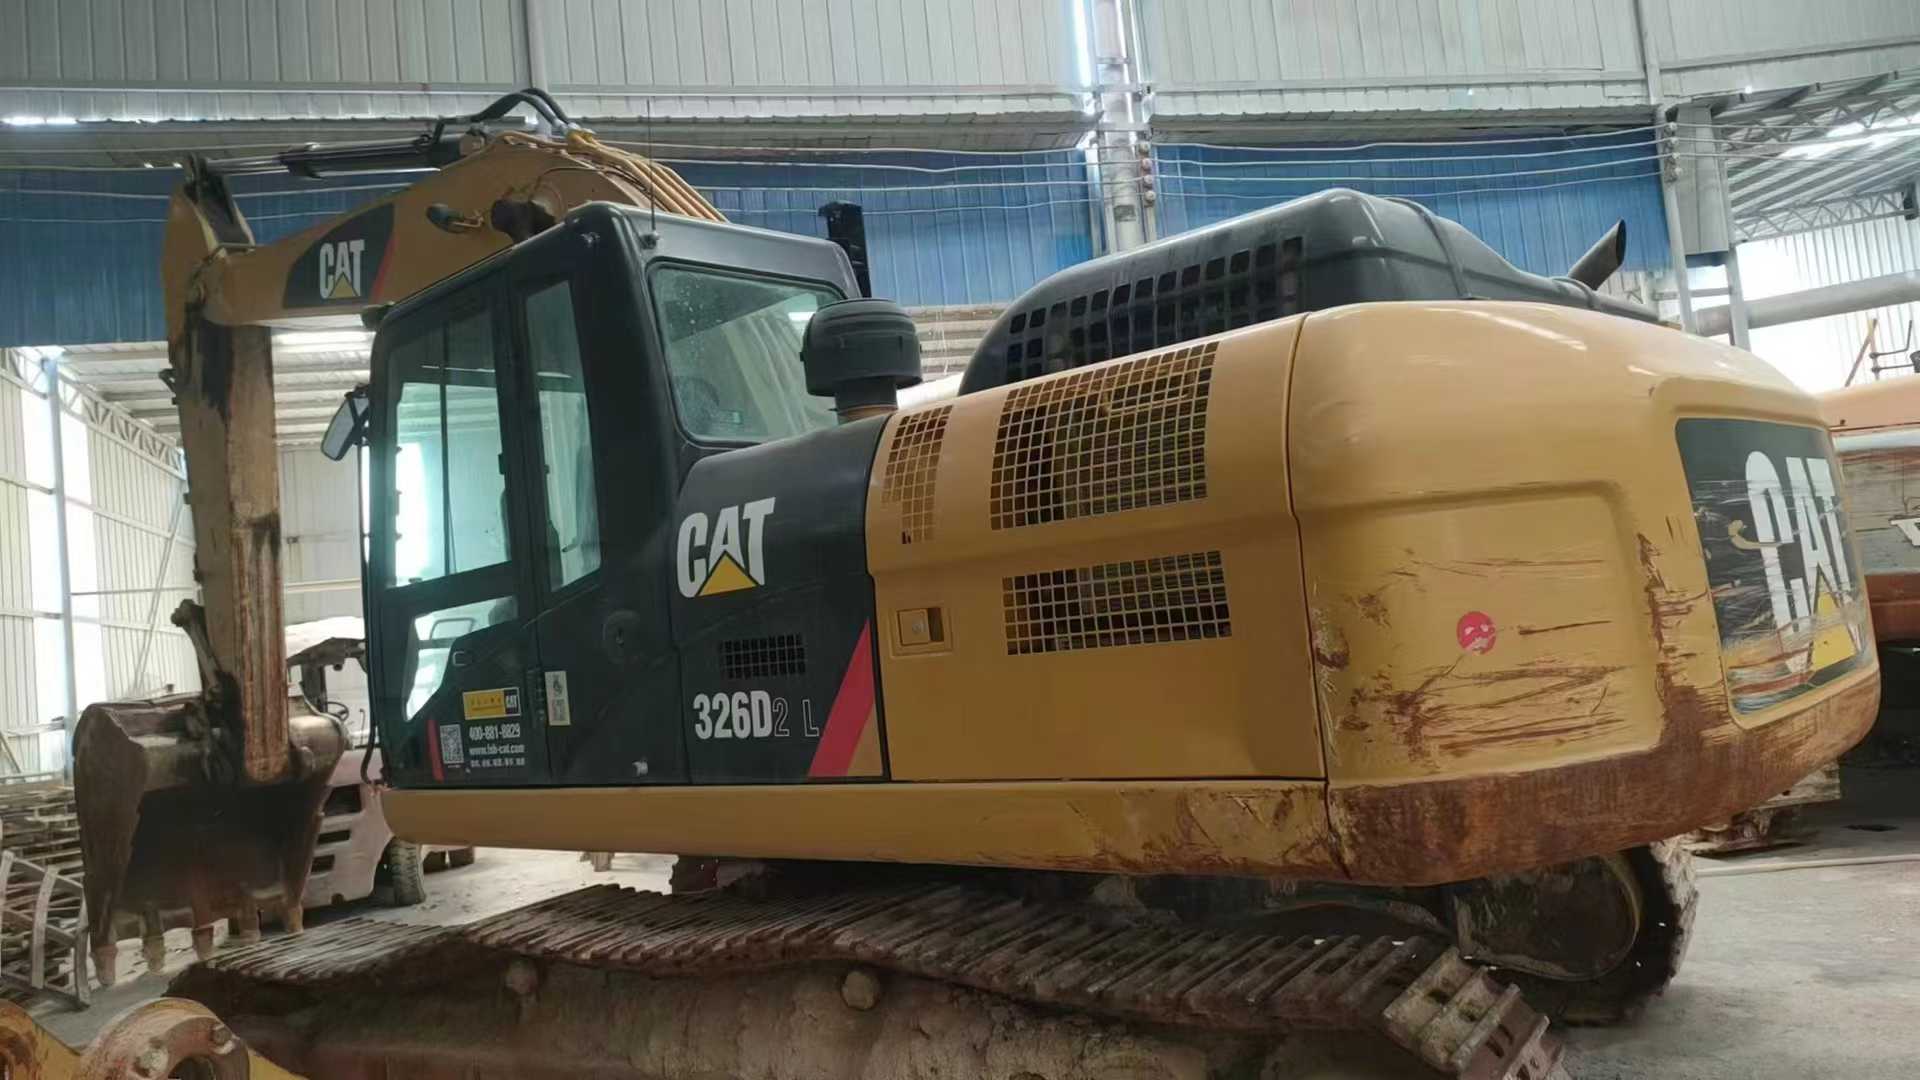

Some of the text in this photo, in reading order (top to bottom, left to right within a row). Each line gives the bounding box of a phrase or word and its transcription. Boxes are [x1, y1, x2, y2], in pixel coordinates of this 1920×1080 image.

[320, 239, 365, 299] CAT
[677, 497, 776, 598] CAT
[1745, 451, 1862, 673] CAT
[802, 698, 820, 738] L
